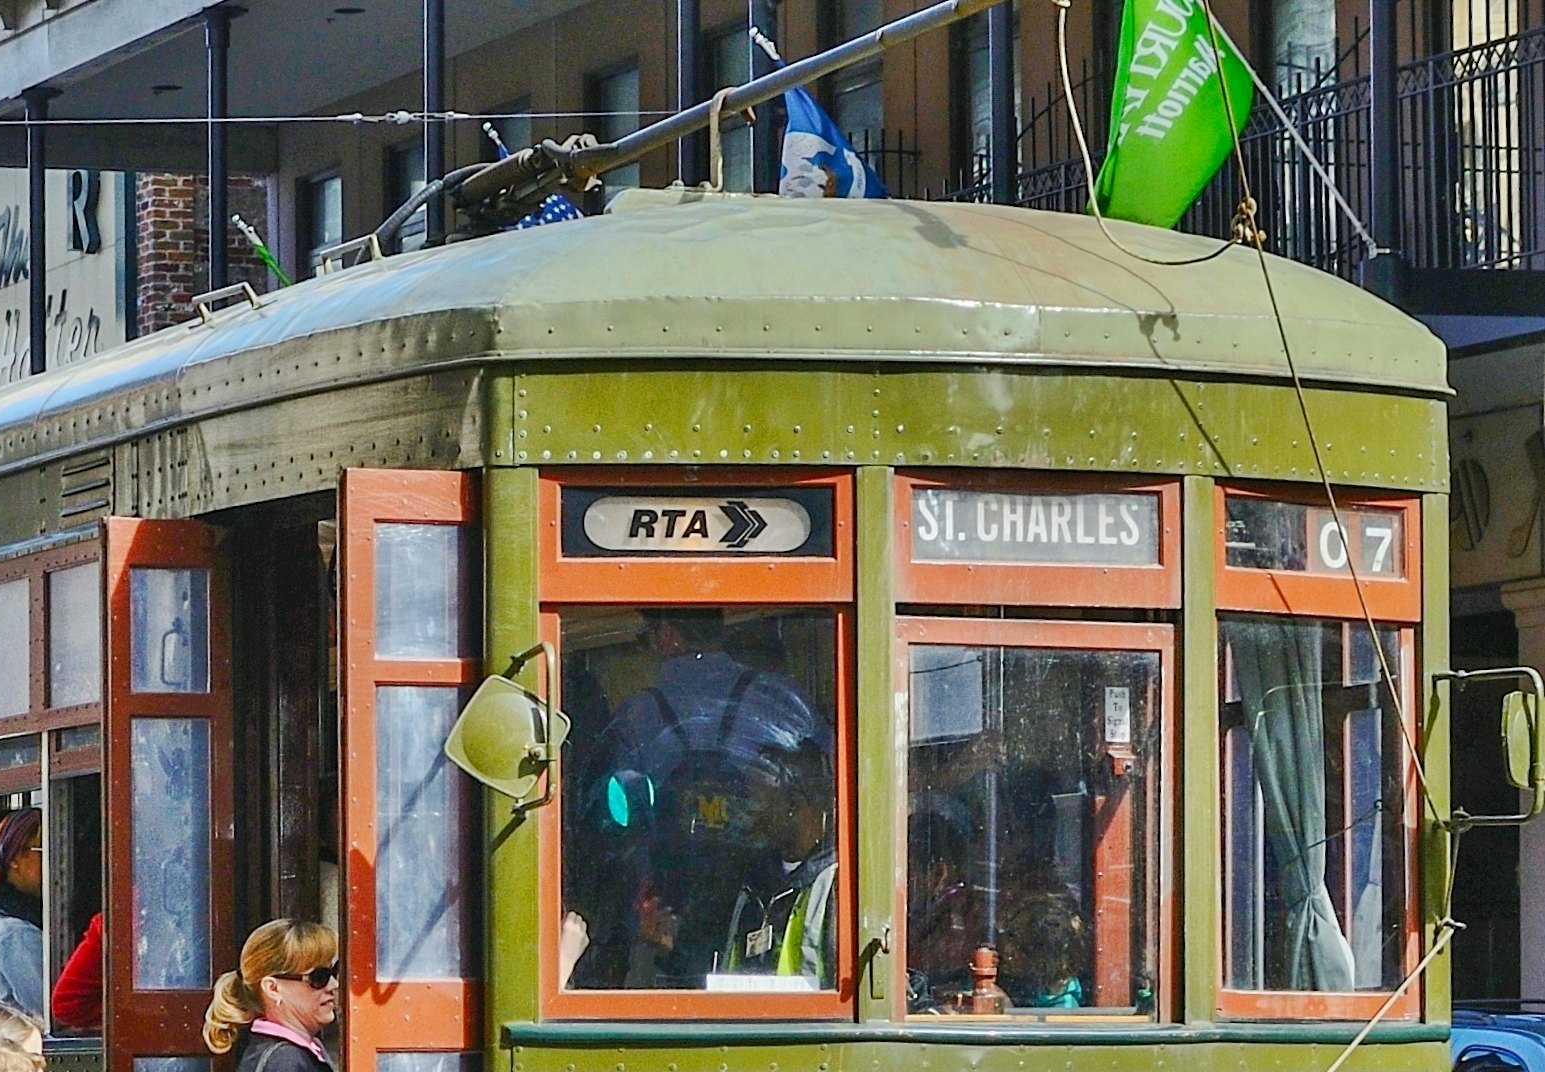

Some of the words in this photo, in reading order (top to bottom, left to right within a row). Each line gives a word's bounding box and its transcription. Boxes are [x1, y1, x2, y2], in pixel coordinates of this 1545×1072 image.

[628, 509, 710, 539] RTA
[917, 496, 966, 542] ST.
[976, 494, 1141, 546] CHARLES
